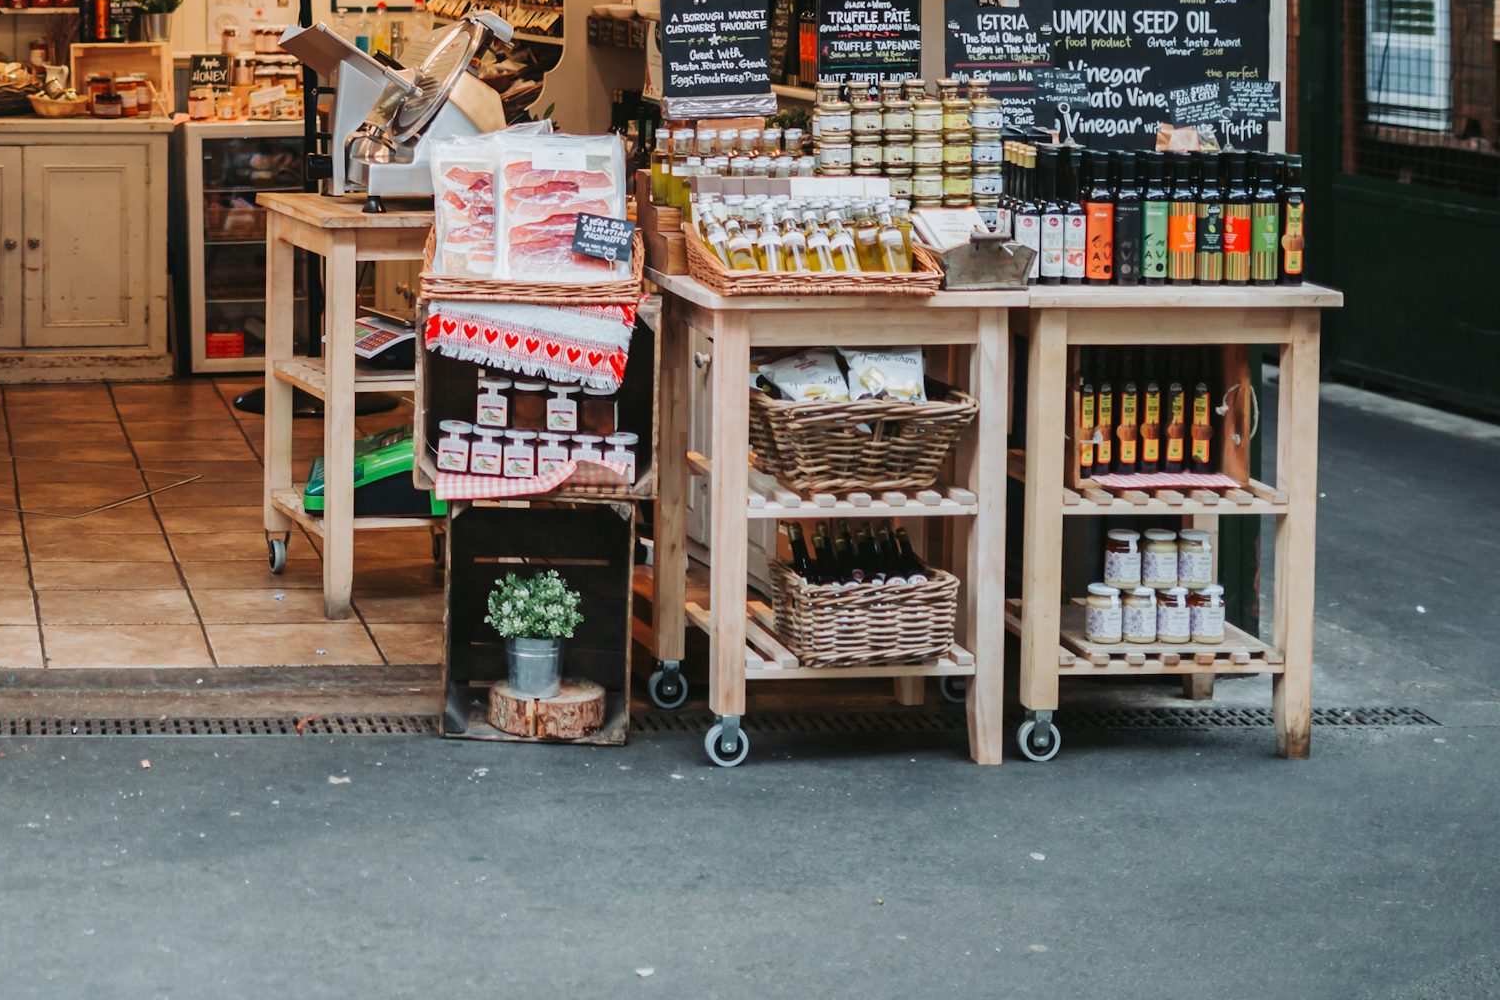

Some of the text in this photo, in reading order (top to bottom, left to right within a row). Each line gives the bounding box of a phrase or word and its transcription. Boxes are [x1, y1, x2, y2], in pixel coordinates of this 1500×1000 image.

[671, 10, 766, 23] A BOROUGH MARKET
[827, 8, 911, 24] TRUFFLE PÂTÉ
[977, 14, 1029, 30] ISTRIA
[1052, 9, 1218, 34] UMPKIN SEED OIL
[666, 21, 767, 34] CUSTOMERS FAVOURITE
[960, 32, 1037, 44] The Best Olive Oil
[831, 40, 921, 51] TRUFFLE TAPENADE
[966, 45, 993, 55] Region
[995, 46, 1003, 54] in
[1003, 44, 1021, 54] The
[689, 47, 743, 60] Great With
[192, 69, 228, 82] HONEY
[1205, 66, 1259, 80] the perfect
